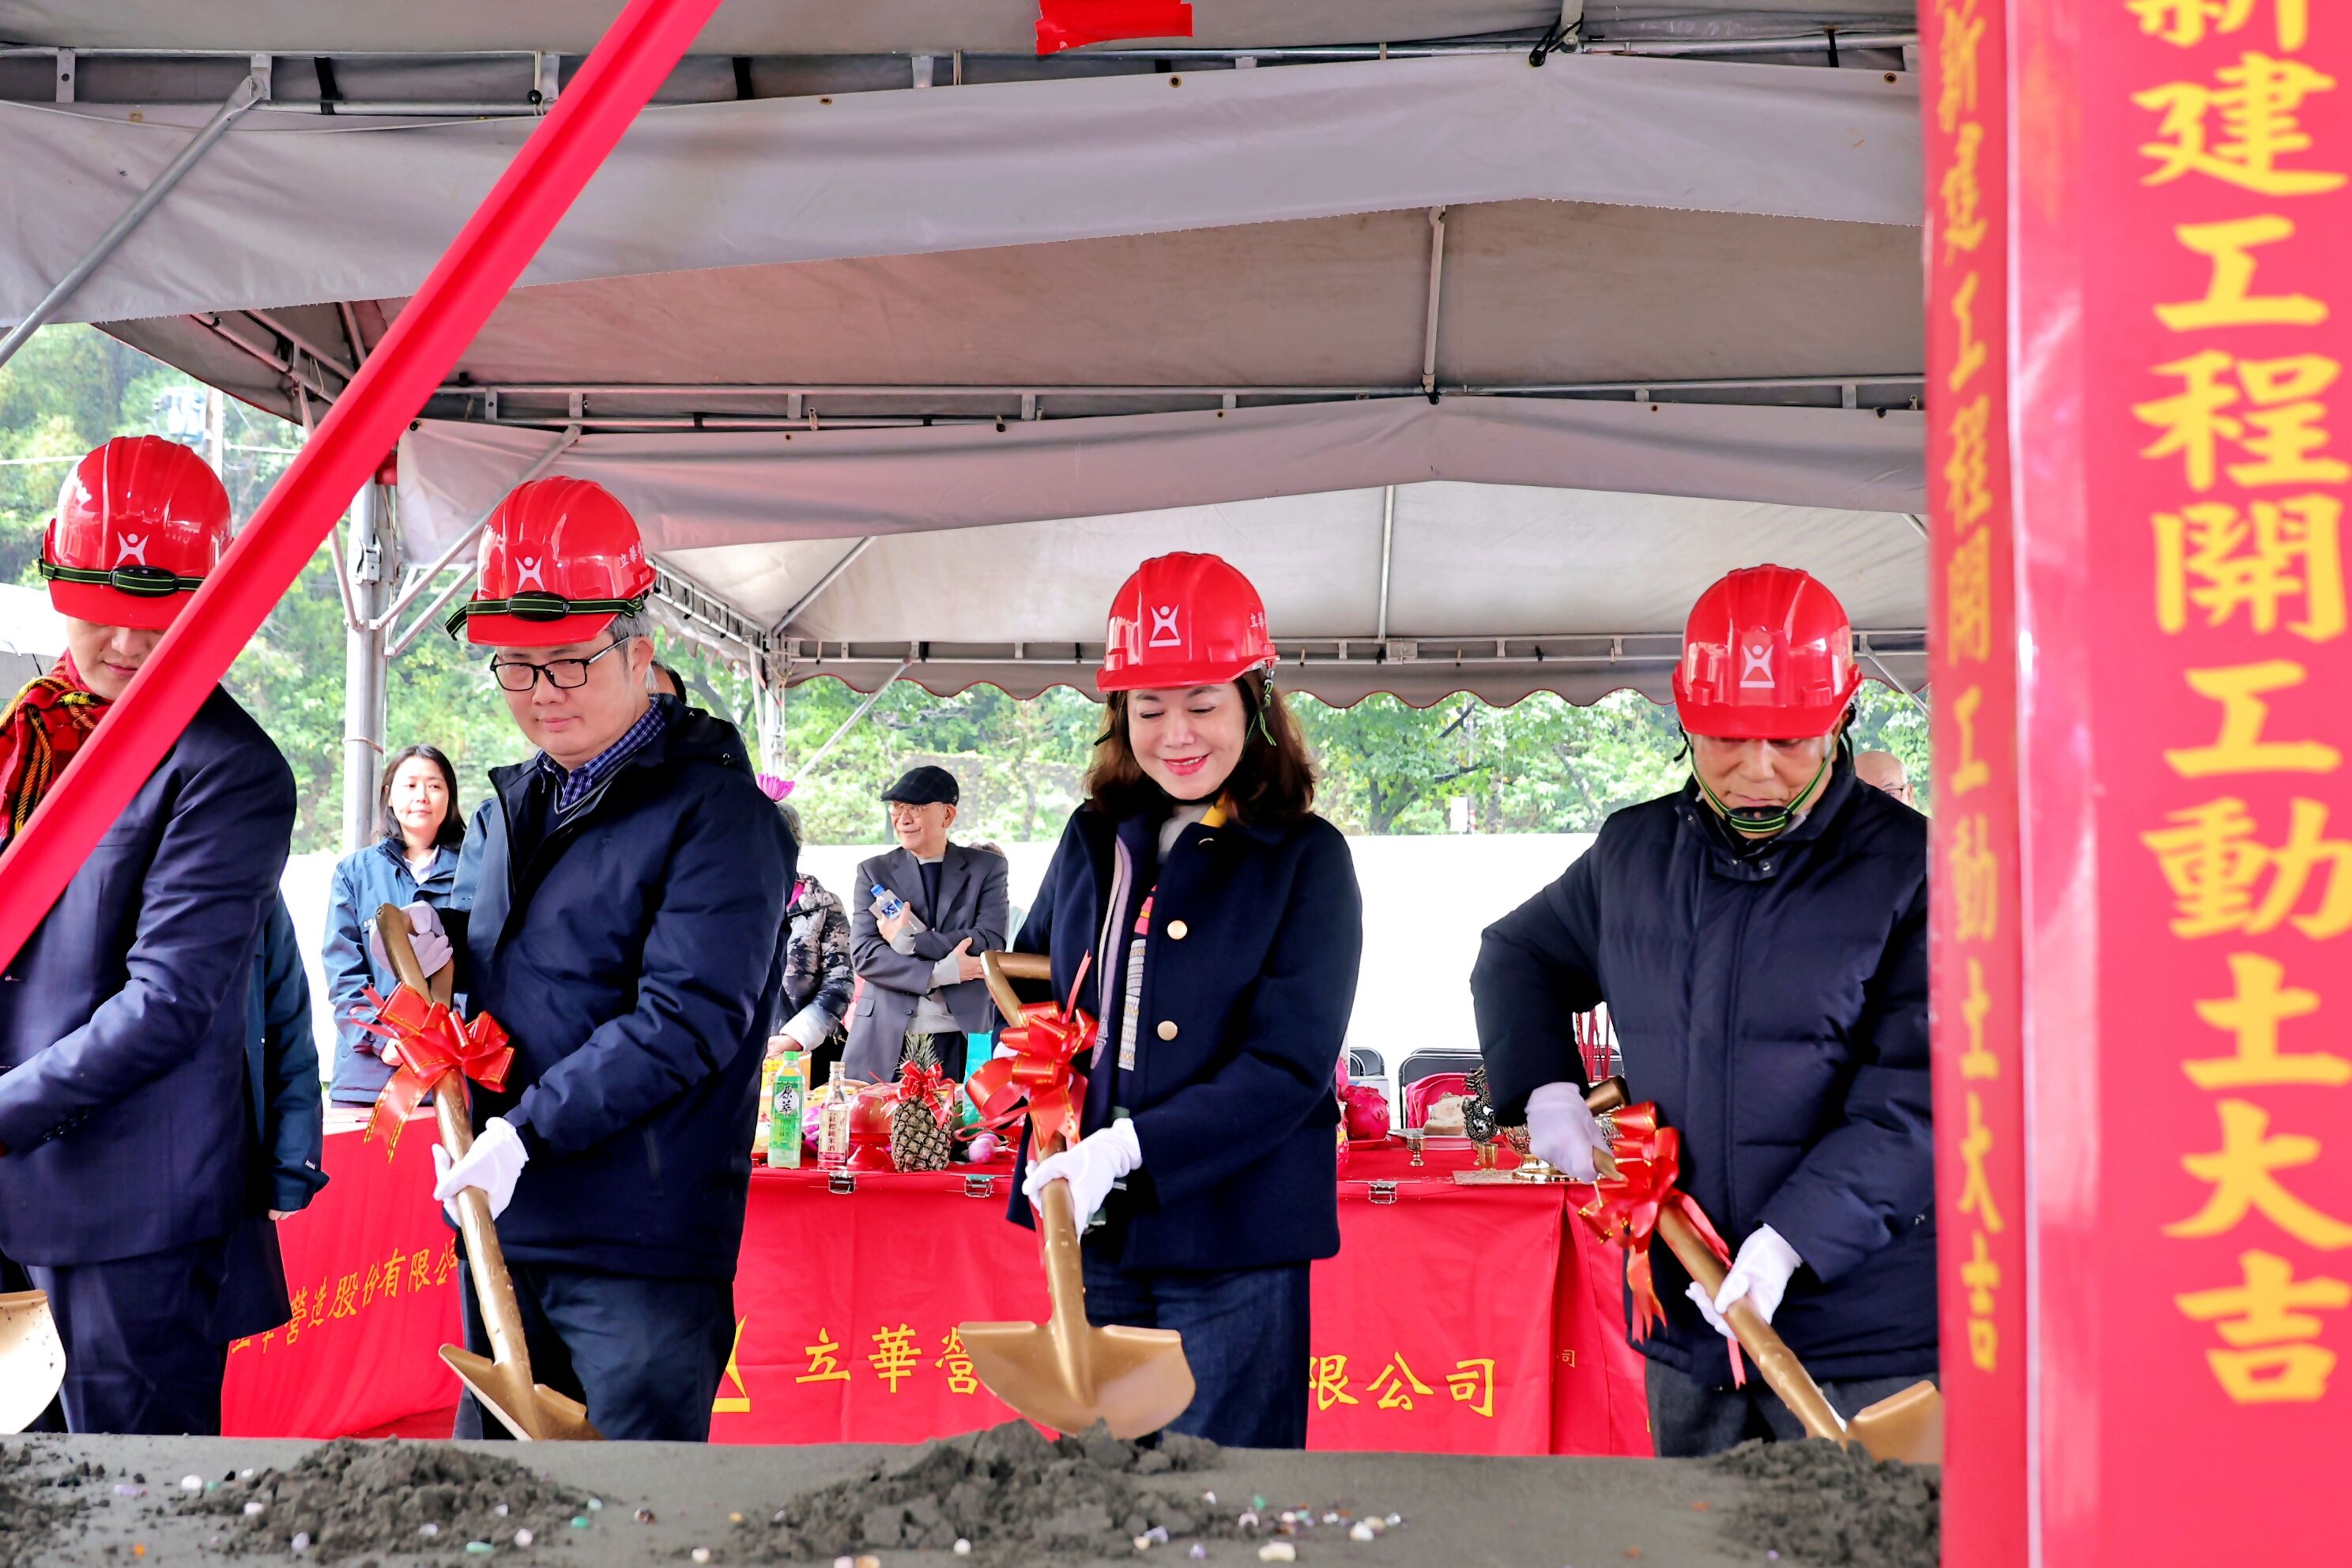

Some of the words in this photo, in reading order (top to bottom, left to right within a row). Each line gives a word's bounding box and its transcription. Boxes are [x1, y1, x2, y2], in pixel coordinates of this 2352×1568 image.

[1936, 0, 2004, 1372] 新建工程開工動土大吉
